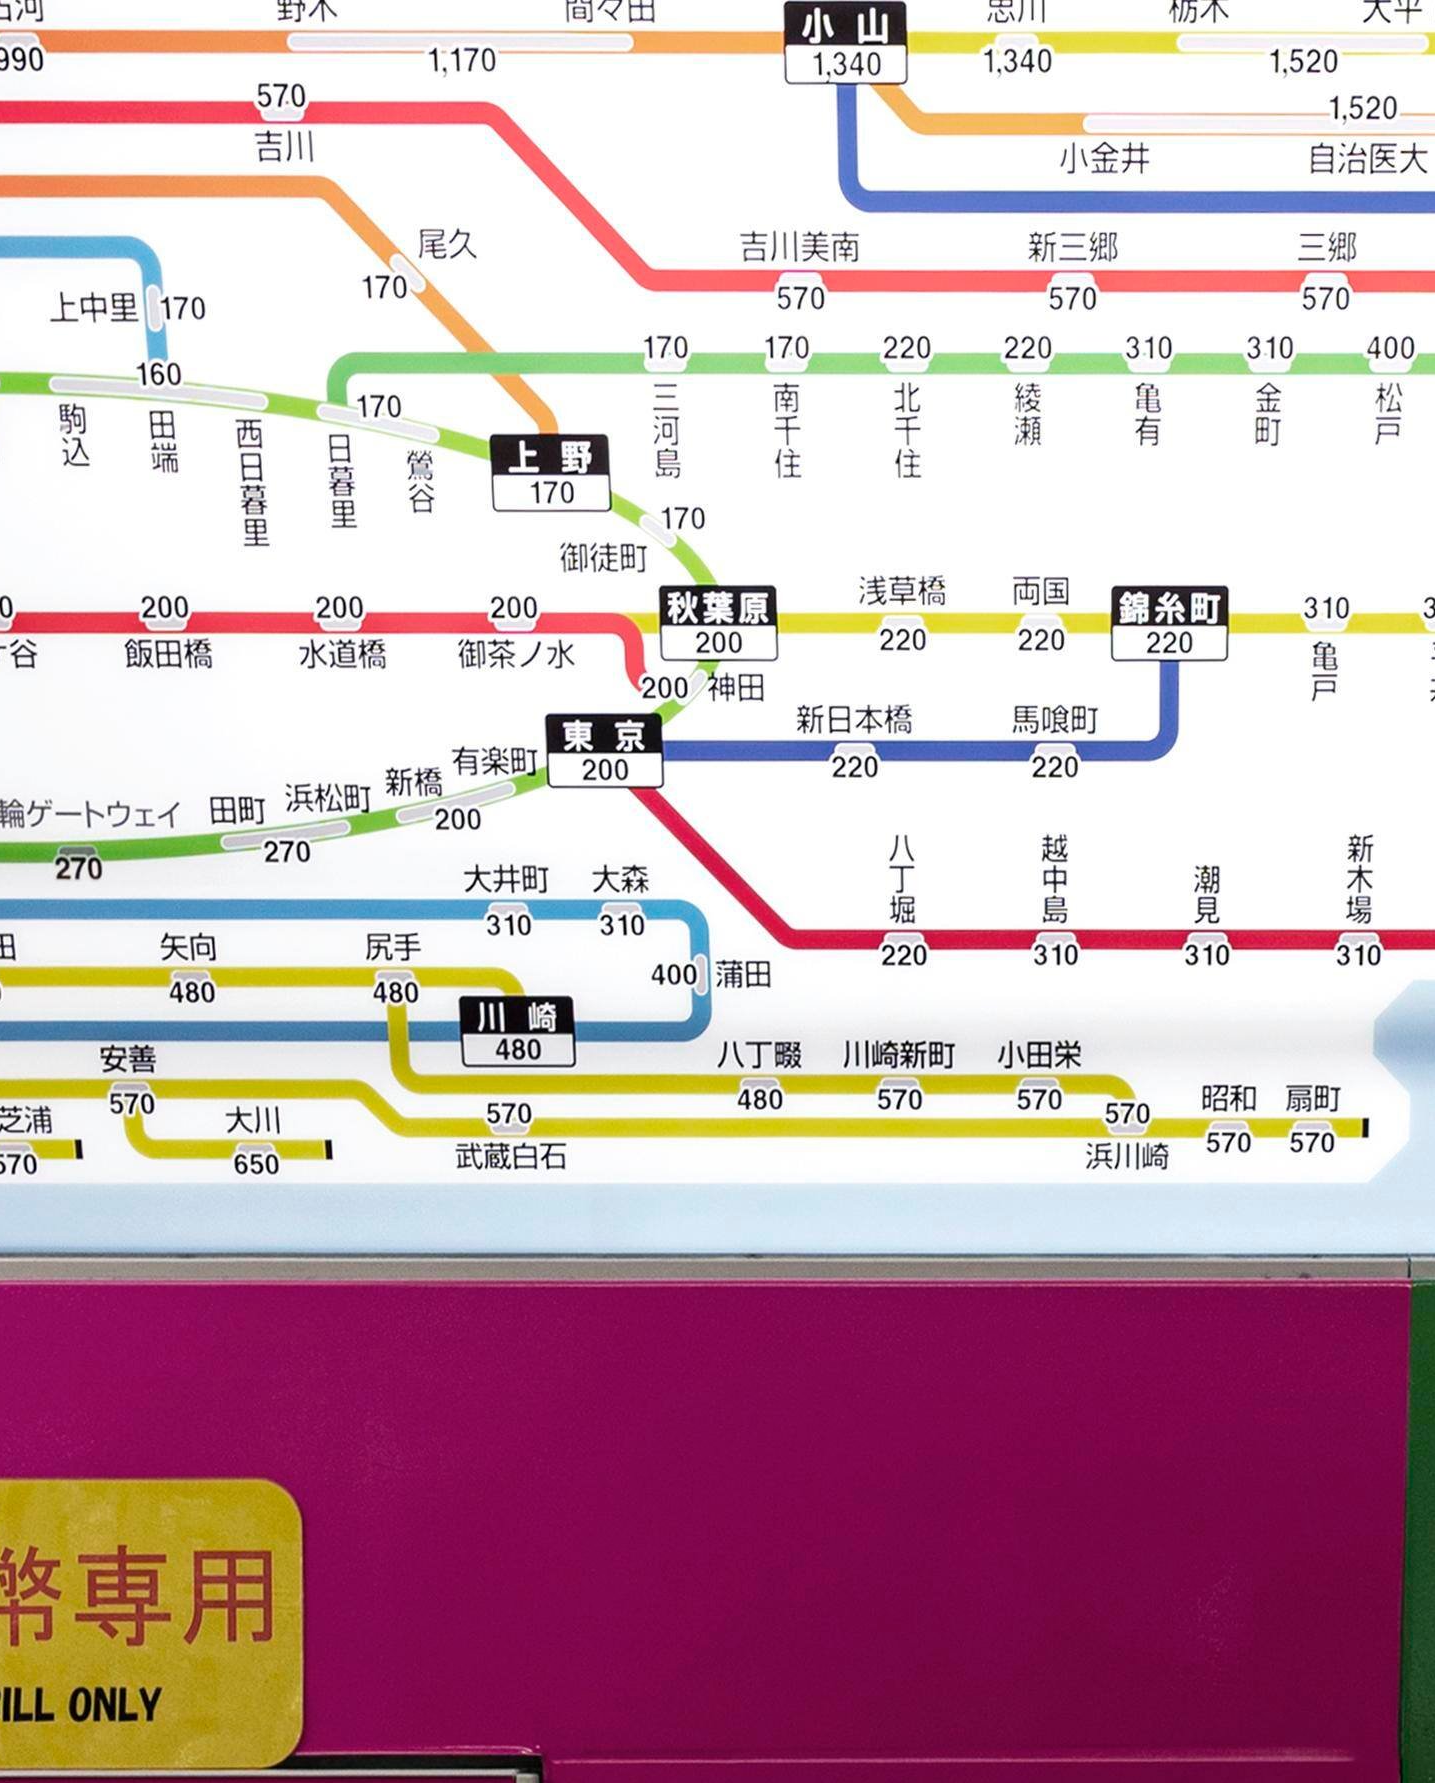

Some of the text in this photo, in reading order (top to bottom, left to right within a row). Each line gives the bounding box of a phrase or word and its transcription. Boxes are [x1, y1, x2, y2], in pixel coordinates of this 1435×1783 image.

[984, 48, 1052, 73] 1,340
[1060, 141, 1149, 174] 小金井
[1311, 142, 1428, 174] 自治医大
[741, 231, 858, 262] 吉川美南
[1028, 231, 1118, 262] 新三郷
[50, 291, 139, 323] 上中里
[162, 296, 206, 320] 170
[778, 286, 825, 310] 570
[653, 384, 681, 479] 三河島
[774, 383, 801, 478] 南千住
[235, 419, 270, 547] 西日暮里
[560, 542, 647, 573] 御徒町
[859, 576, 945, 606] 浅草橋
[667, 590, 769, 625] 秋葉原
[1116, 591, 1225, 628] 錦糸町
[124, 638, 212, 669] 飯田橋
[797, 704, 912, 734] 新日本橋
[1012, 704, 1098, 735] 馬喰町
[285, 783, 371, 814] 浜松町
[717, 1041, 802, 1069] 八丁畷
[843, 1040, 956, 1069] 川崎新町
[997, 1039, 1081, 1069] 小田栄
[737, 1088, 783, 1110] 480
[1086, 1142, 1169, 1170] 浜川崎
[68, 1686, 163, 1723] ONLY
